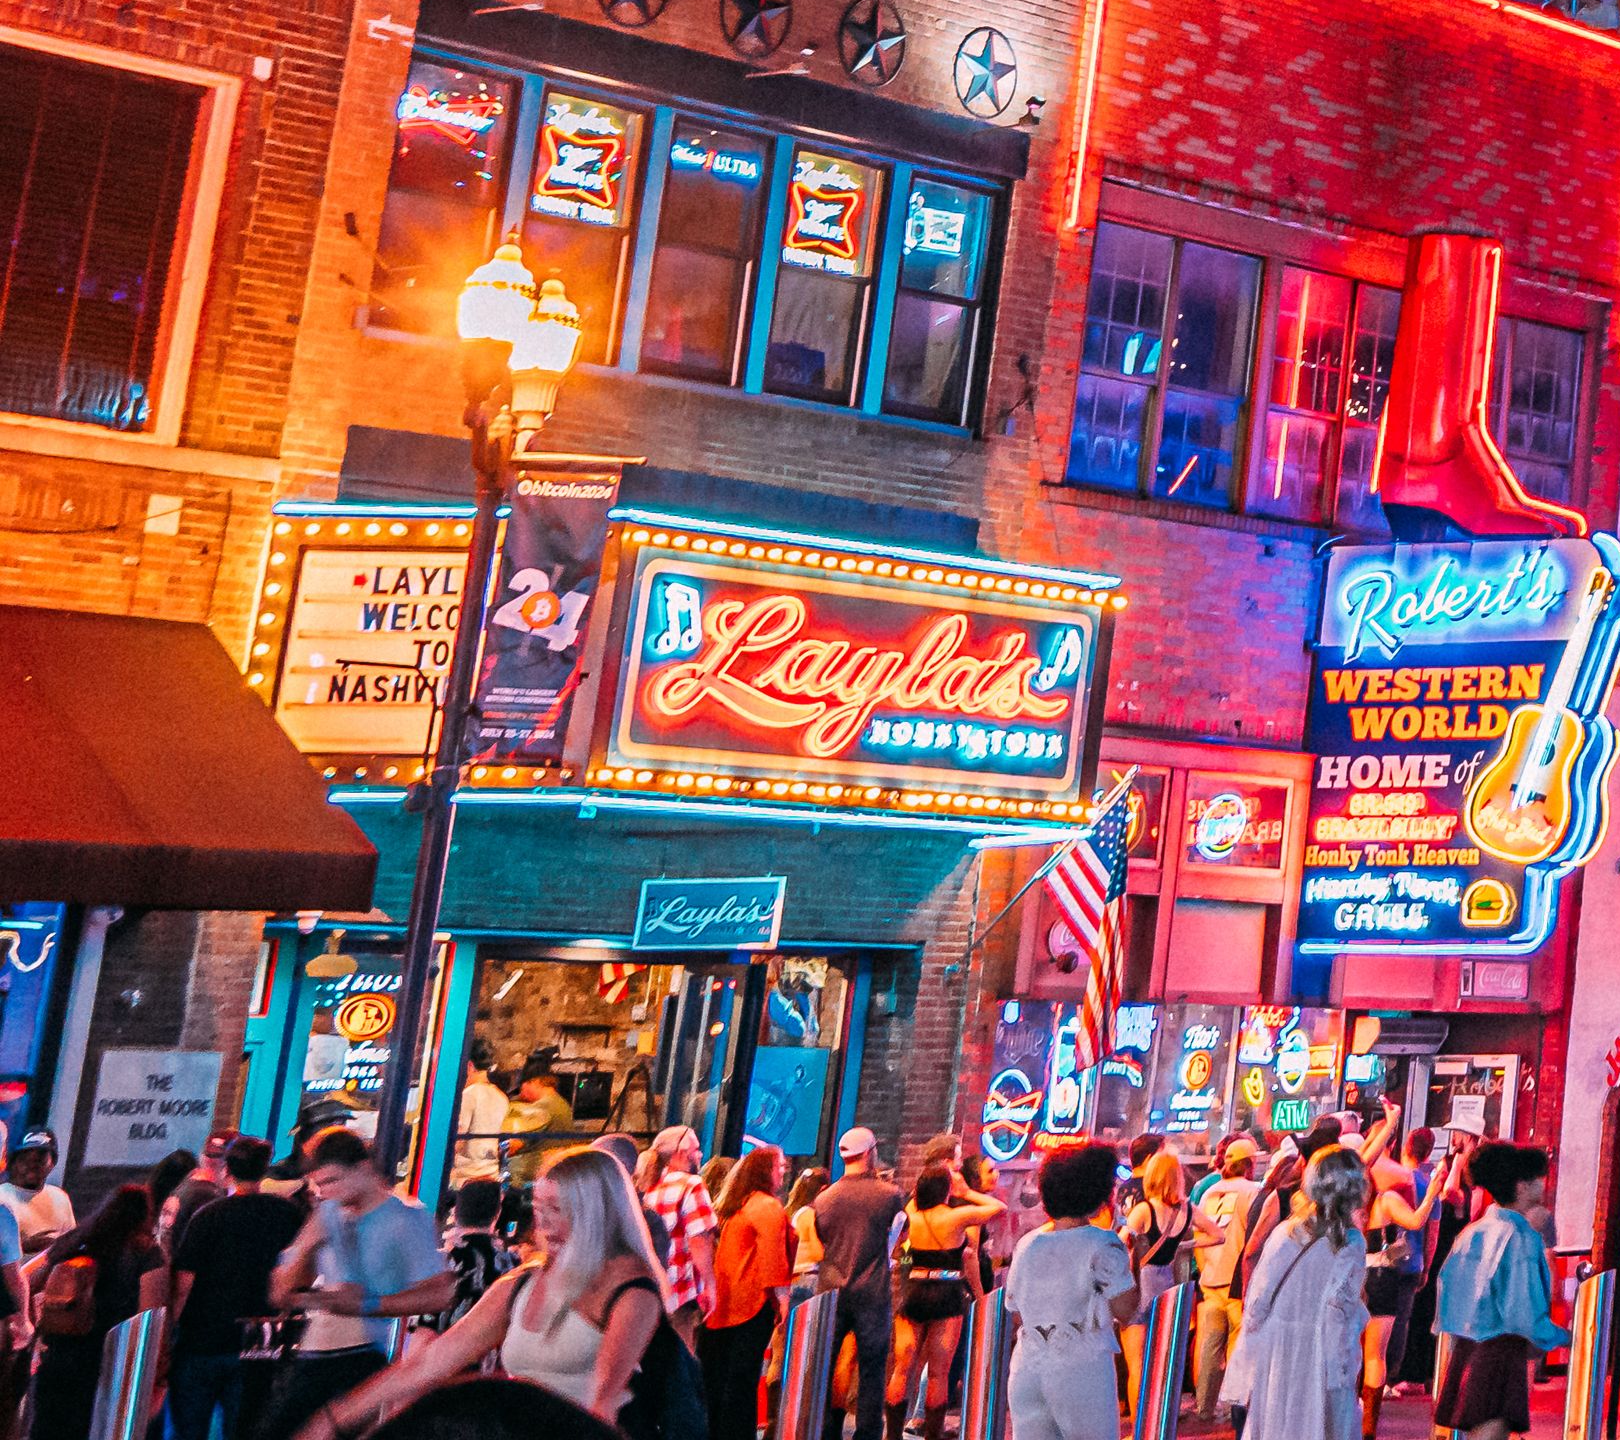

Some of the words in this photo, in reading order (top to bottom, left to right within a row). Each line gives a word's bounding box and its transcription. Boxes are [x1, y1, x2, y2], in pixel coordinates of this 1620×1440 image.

[517, 479, 614, 500] @bitcoin2024
[372, 566, 458, 596] LAYL
[362, 602, 460, 632] WELCO
[1343, 549, 1558, 663] Robert's
[413, 640, 449, 669] TO
[653, 594, 1070, 758] Layla's
[1323, 664, 1545, 704] WESTERN
[1350, 704, 1508, 742] WORLD
[868, 718, 966, 749] HONKY
[989, 729, 1064, 760] TONK
[1316, 753, 1450, 791] HOME
[1453, 750, 1485, 796] of
[1304, 844, 1362, 872] Honky
[1365, 845, 1410, 866] Tonk
[1411, 845, 1480, 867] Heaven
[646, 894, 771, 941] Layla's
[1477, 964, 1523, 990] Coca-Cola
[145, 1073, 175, 1091] THE
[97, 1098, 155, 1118] ROBERT
[159, 1098, 212, 1117] MOORE
[1271, 1099, 1310, 1130] ATM
